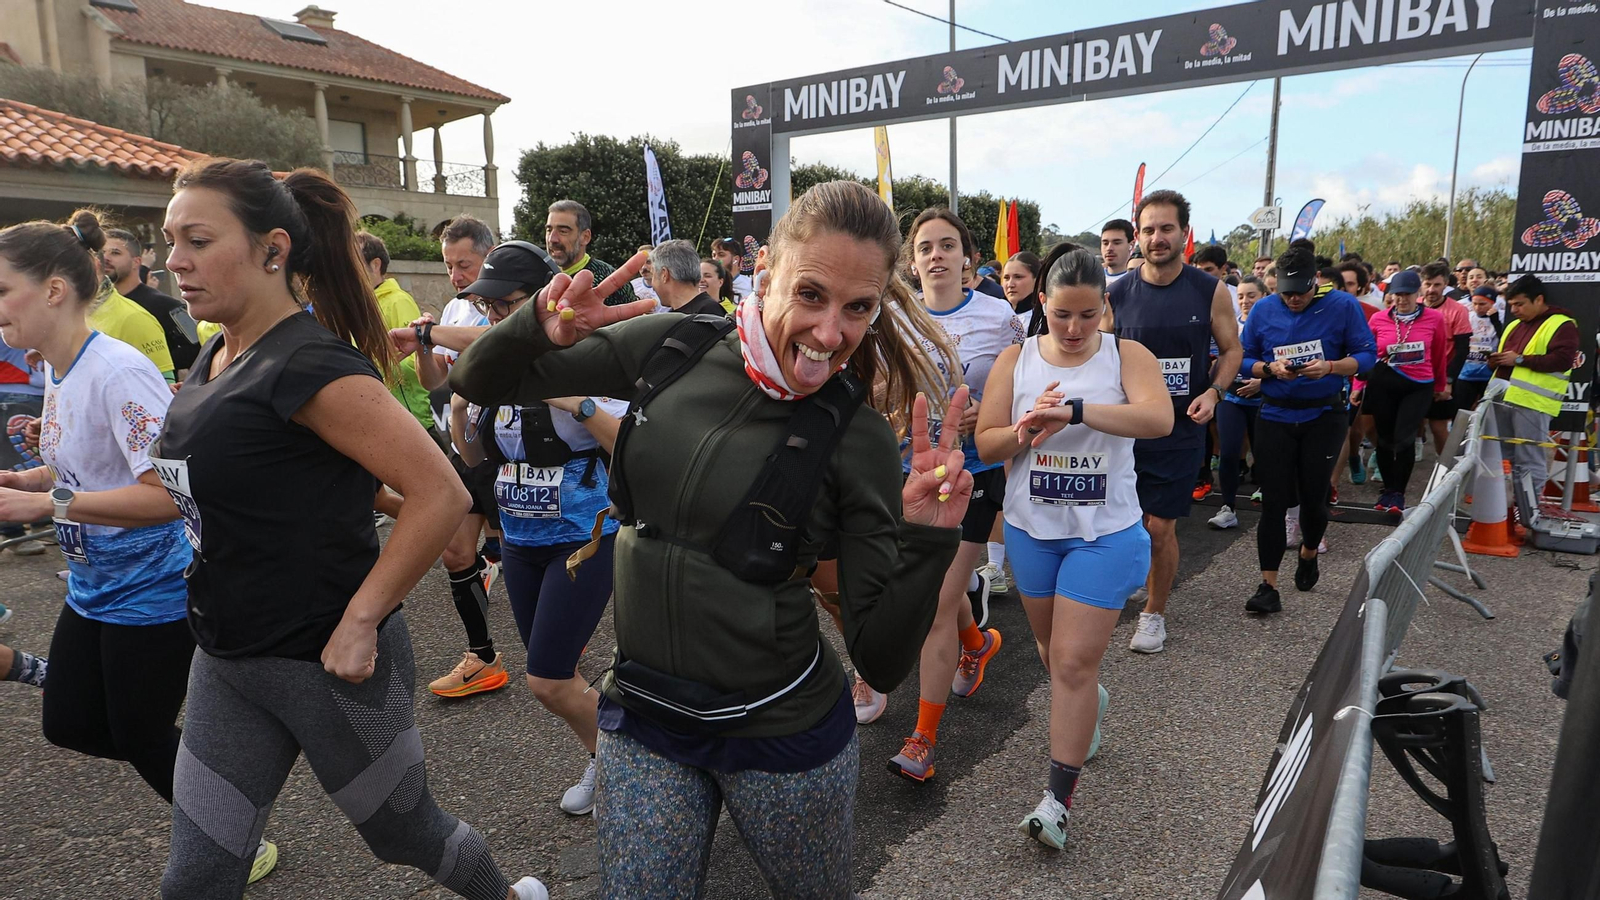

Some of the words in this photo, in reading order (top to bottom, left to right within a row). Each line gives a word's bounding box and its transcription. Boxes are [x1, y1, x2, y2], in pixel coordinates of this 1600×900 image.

[1543, 8, 1555, 18] De
[1557, 7, 1566, 17] la
[1567, 4, 1599, 16] media,
[1277, 0, 1498, 56] MINIBAY
[997, 29, 1163, 94] MINIBAY
[1184, 60, 1193, 69] De
[1194, 59, 1201, 68] la
[1201, 56, 1223, 66] media,
[1224, 55, 1231, 64] la
[1232, 52, 1252, 63] mitad
[784, 70, 907, 122] MINIBAY
[926, 97, 933, 105] De
[939, 94, 955, 103] media,
[955, 92, 961, 101] la
[961, 91, 976, 100] mitad
[1531, 143, 1541, 151] De
[1543, 142, 1551, 150] la
[1552, 140, 1578, 150] media,
[1580, 139, 1588, 148] la
[733, 190, 771, 205] MINIBAY
[1510, 251, 1600, 272] MINIBAY
[1573, 273, 1595, 281] mitad
[1277, 342, 1318, 356] MINIBAY
[1158, 361, 1186, 370] IBAY
[1036, 454, 1102, 469] MINIBAY
[1042, 474, 1096, 491] 11761
[503, 484, 551, 503] 10812
